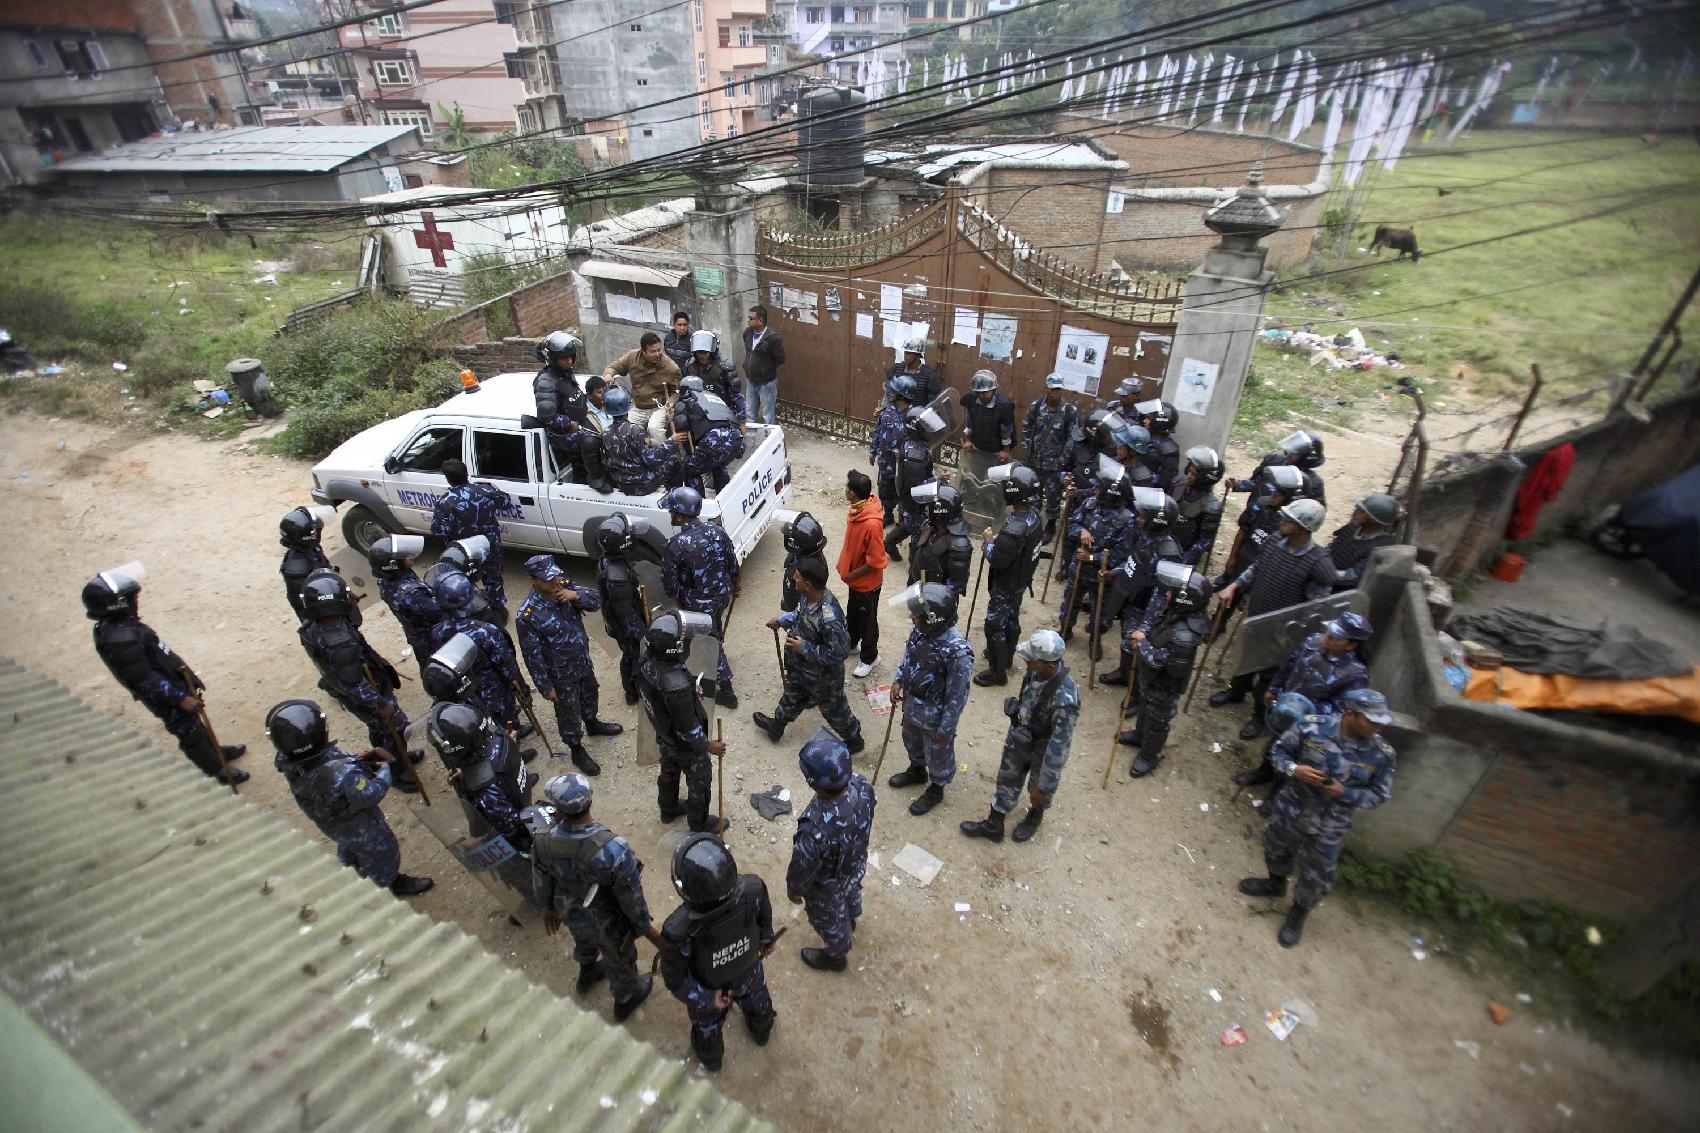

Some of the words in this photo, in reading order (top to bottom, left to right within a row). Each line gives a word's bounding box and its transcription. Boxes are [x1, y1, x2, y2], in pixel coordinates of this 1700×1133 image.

[396, 489, 437, 509] METROP
[741, 467, 773, 515] POLICE
[317, 593, 335, 601] POLICE
[537, 806, 552, 825] NEPAL
[712, 936, 751, 961] NEPAL
[712, 942, 751, 969] POLICE
